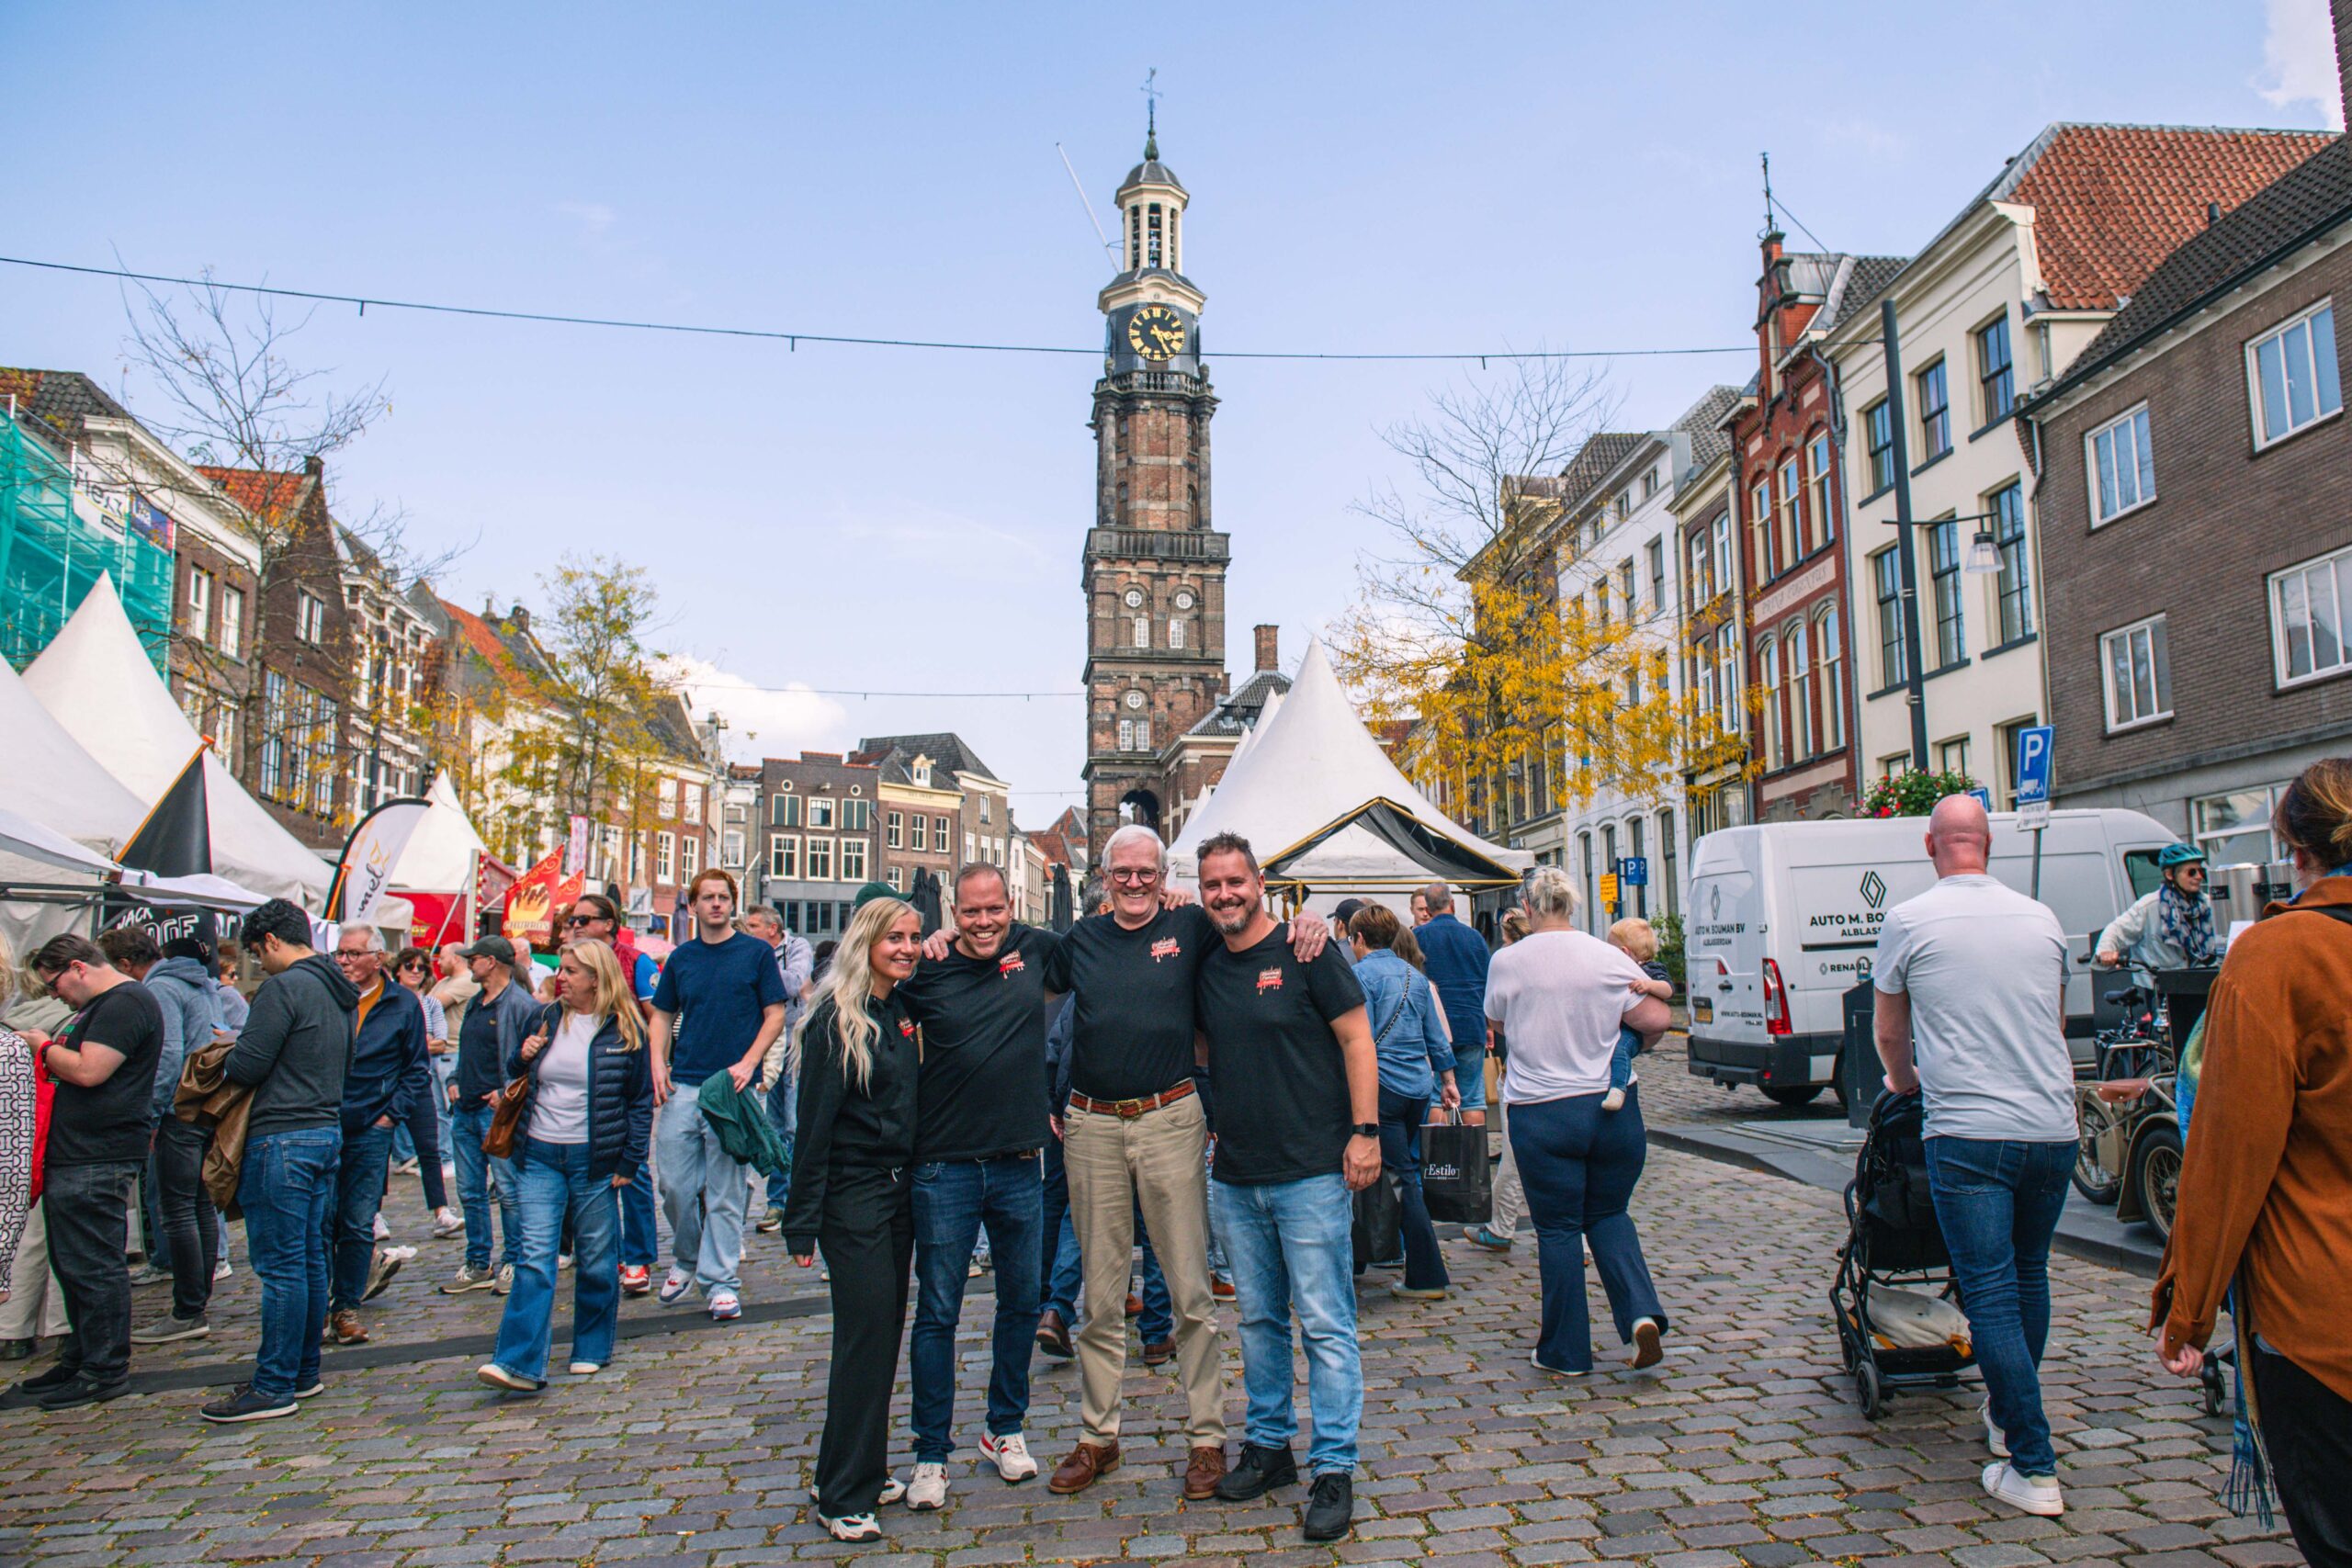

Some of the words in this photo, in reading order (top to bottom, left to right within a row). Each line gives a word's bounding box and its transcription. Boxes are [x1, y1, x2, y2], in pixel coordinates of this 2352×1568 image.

[2025, 734, 2043, 771] P
[117, 907, 153, 930] JACK
[1810, 914, 1846, 926] AUTO
[1848, 913, 1863, 924] M.
[1867, 911, 1887, 923] BO
[1695, 926, 1705, 935] AUTO
[1712, 924, 1735, 934] BOUMAN
[1736, 923, 1745, 933] BV
[1429, 1163, 1456, 1176] Estilo
